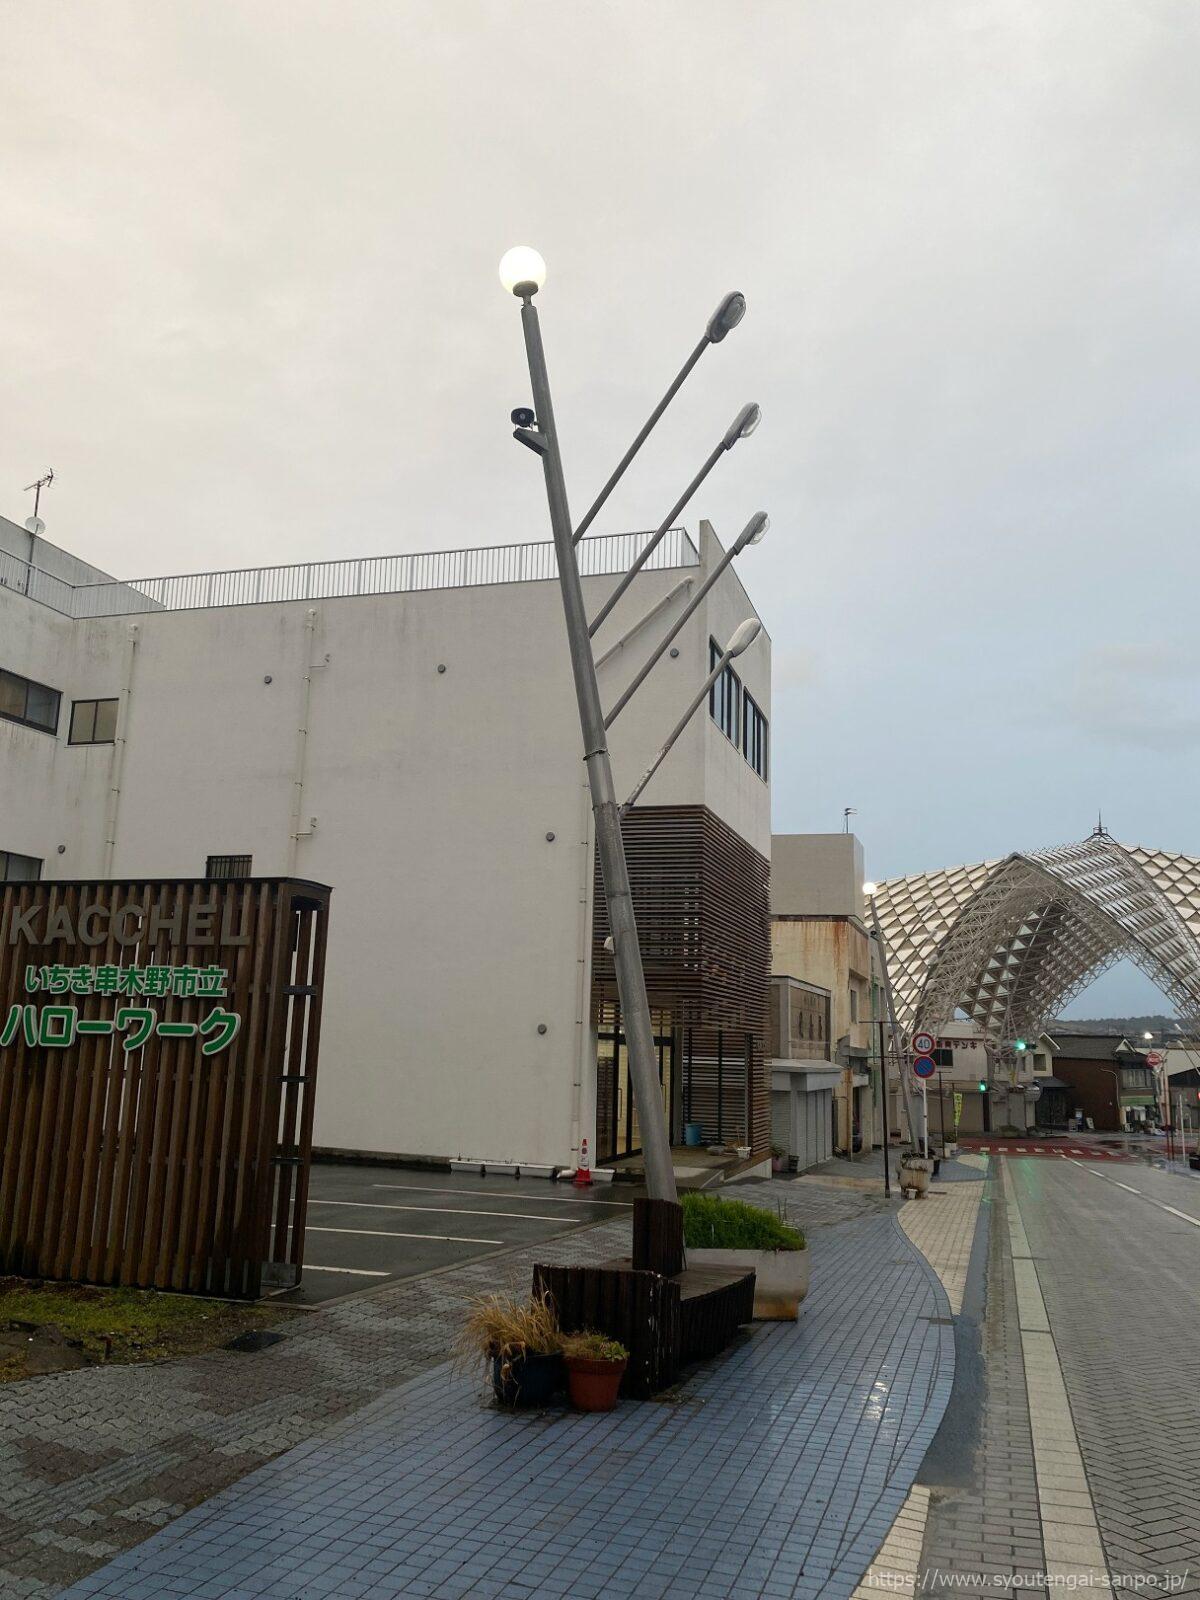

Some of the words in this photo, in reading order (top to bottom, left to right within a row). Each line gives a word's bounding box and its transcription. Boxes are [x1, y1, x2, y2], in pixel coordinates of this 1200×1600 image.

[25, 964, 228, 997] いちき串木野市立
[0, 1005, 241, 1055] ハローワーク
[917, 1038, 930, 1049] 40
[936, 1040, 977, 1050] デンキ
